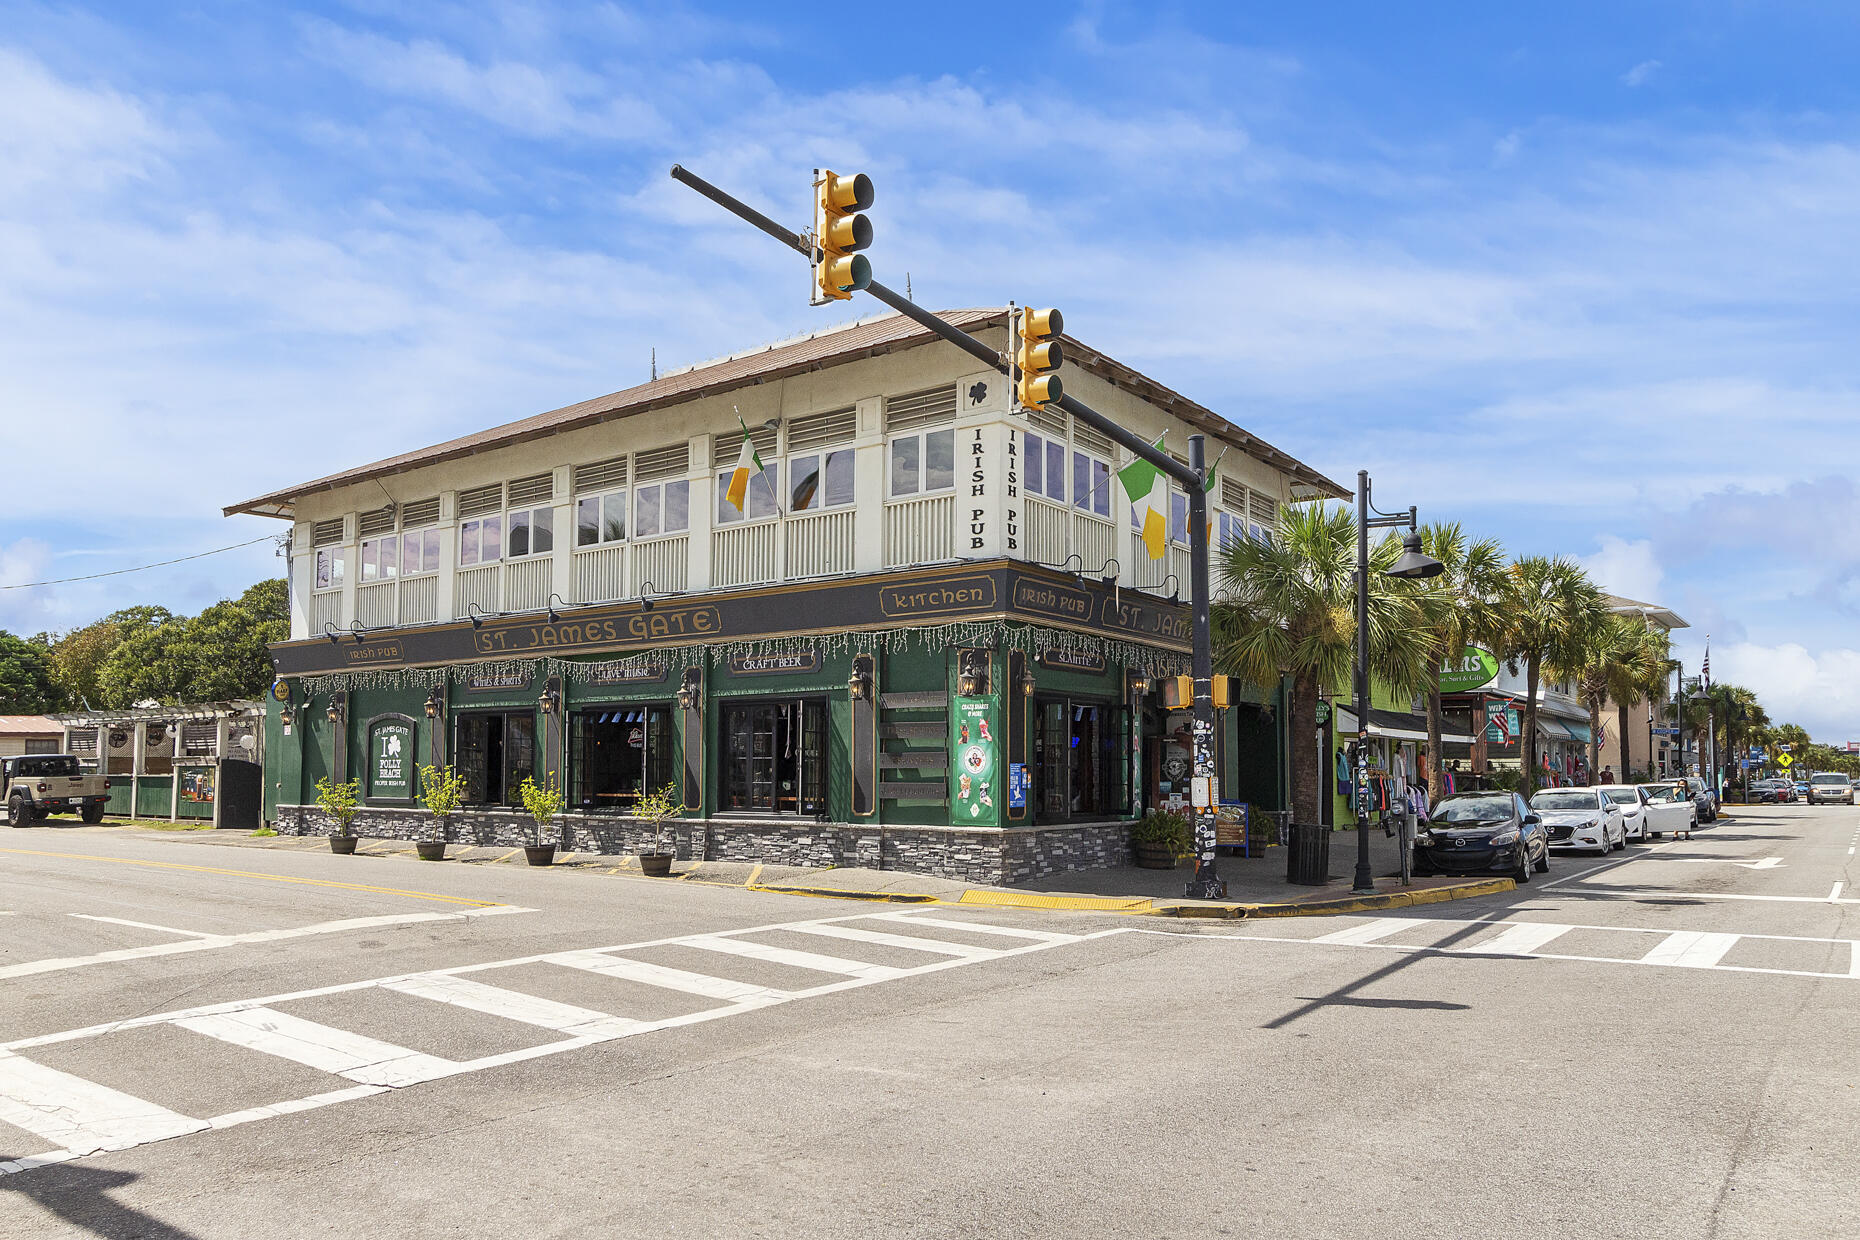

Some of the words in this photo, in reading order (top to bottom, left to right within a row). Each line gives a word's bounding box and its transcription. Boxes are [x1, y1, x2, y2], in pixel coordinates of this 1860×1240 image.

[971, 428, 985, 497] IRISH
[1007, 429, 1017, 498] IRISH
[970, 508, 985, 550] PUB
[1007, 508, 1018, 550] PUB
[1059, 595, 1085, 614] PUB
[481, 630, 517, 650] ST.
[529, 620, 617, 647] JAMES
[628, 609, 712, 639] GATE
[378, 646, 398, 657] PUB
[624, 667, 650, 678] MUSIC
[743, 658, 776, 670] CRAFT
[779, 656, 801, 668] BEER
[395, 725, 409, 736] GATE
[381, 736, 388, 758] I
[379, 759, 402, 769] FOLLY
[379, 769, 402, 778] BEACH
